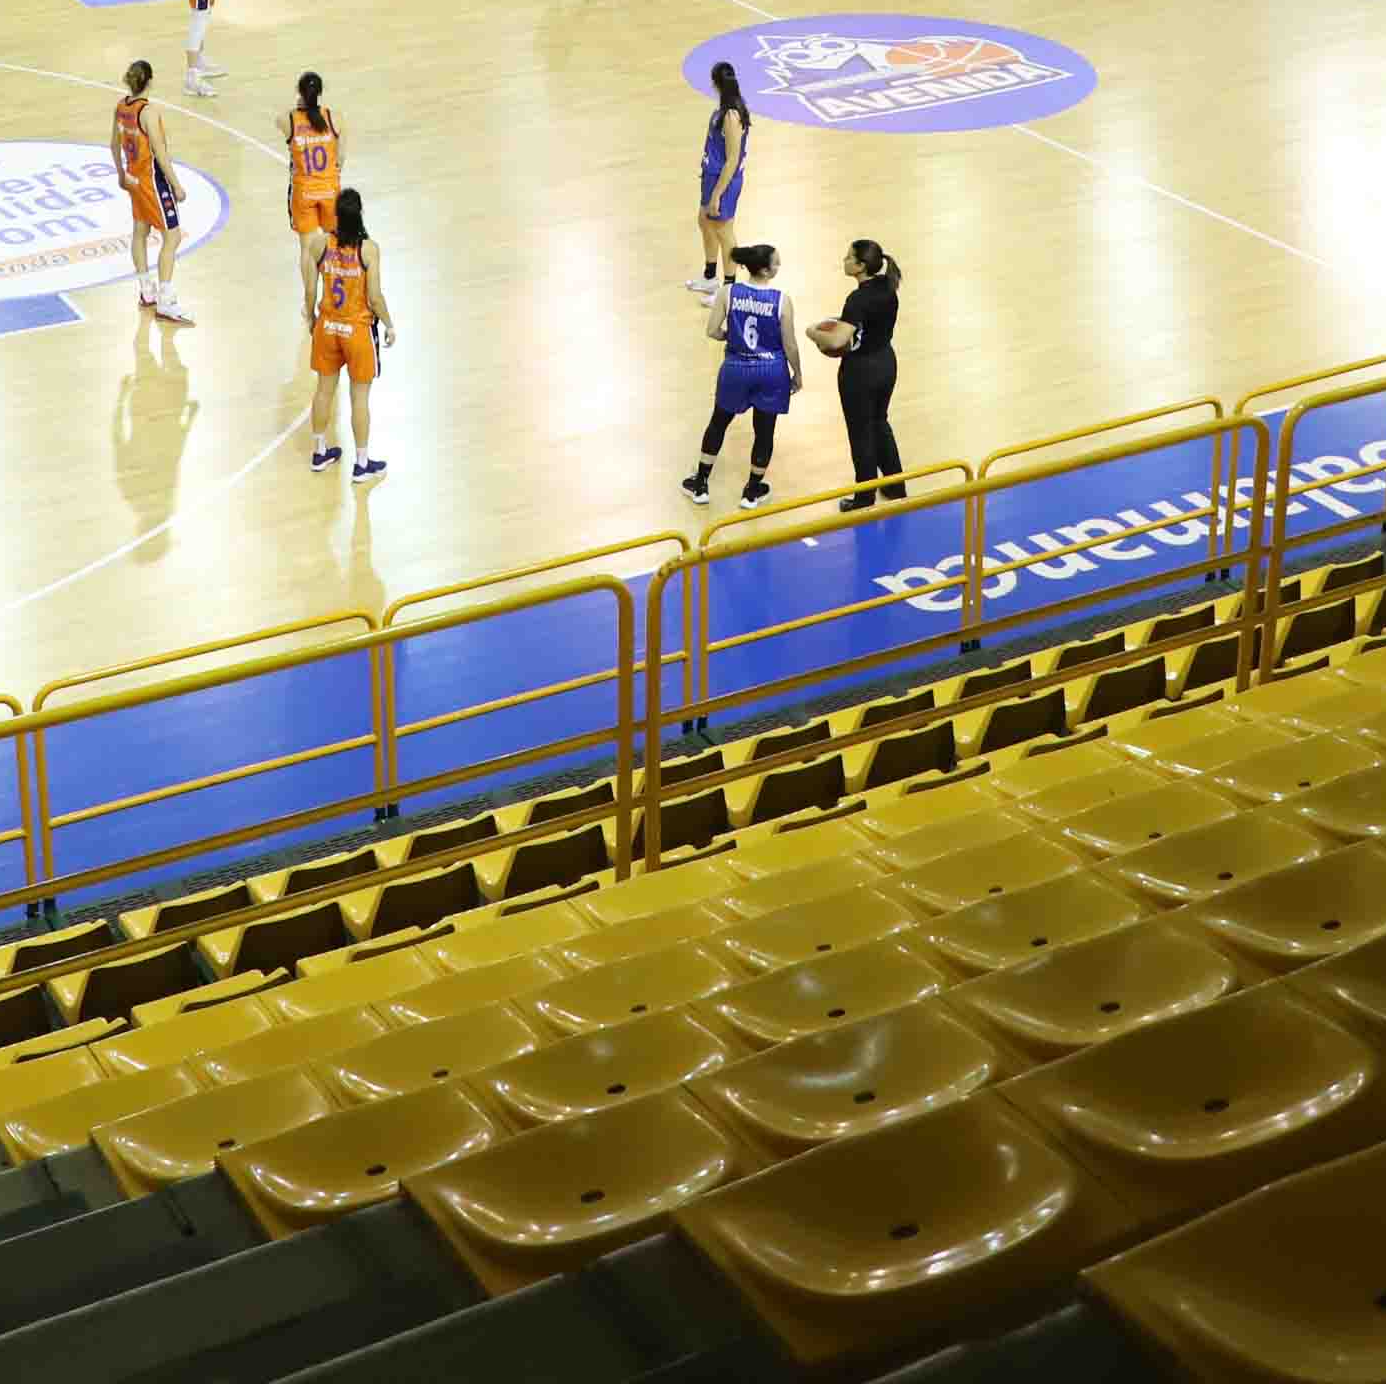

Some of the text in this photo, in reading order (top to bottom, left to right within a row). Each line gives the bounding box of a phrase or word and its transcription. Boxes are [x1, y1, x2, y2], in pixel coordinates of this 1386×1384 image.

[815, 62, 1053, 119] AVENIDA
[303, 144, 328, 176] 10
[331, 276, 346, 309] 5
[743, 315, 759, 351] 6
